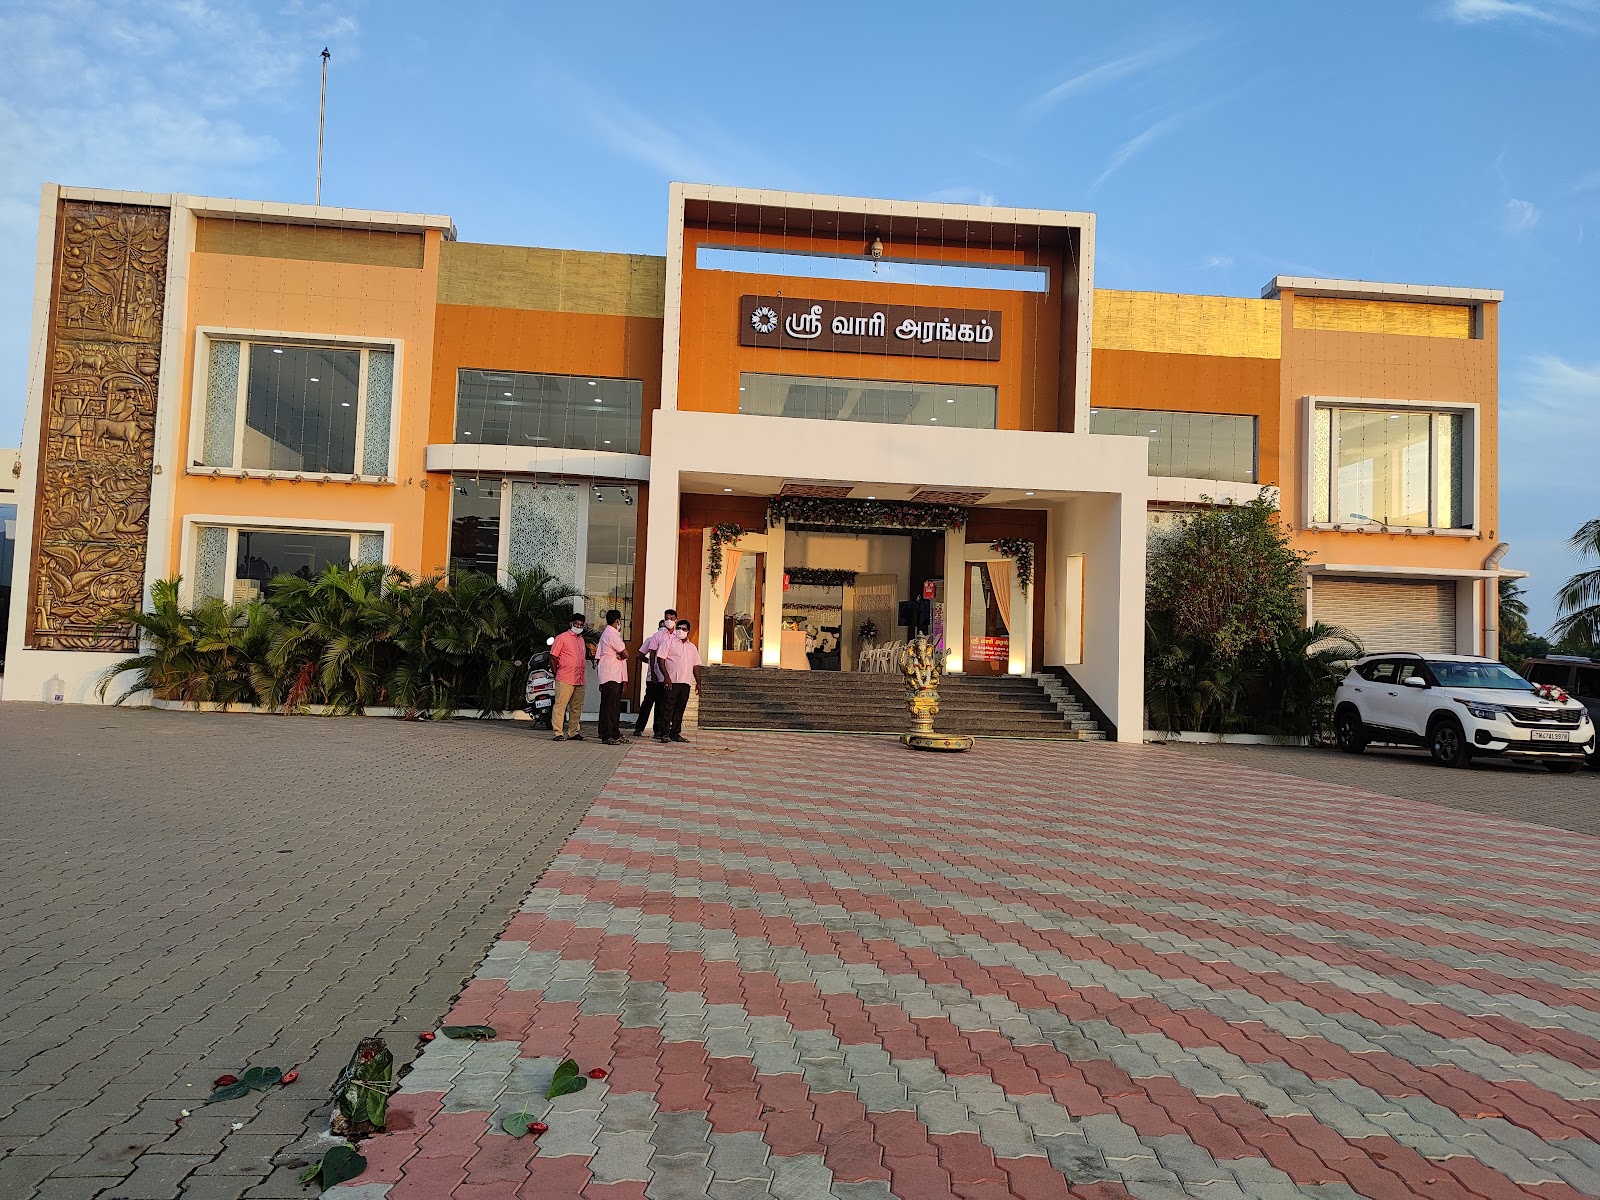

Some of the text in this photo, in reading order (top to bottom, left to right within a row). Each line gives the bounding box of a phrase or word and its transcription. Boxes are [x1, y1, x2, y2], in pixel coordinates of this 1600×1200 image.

[785, 304, 994, 344] ஸ்ரீ வாரி அரங்கம்
